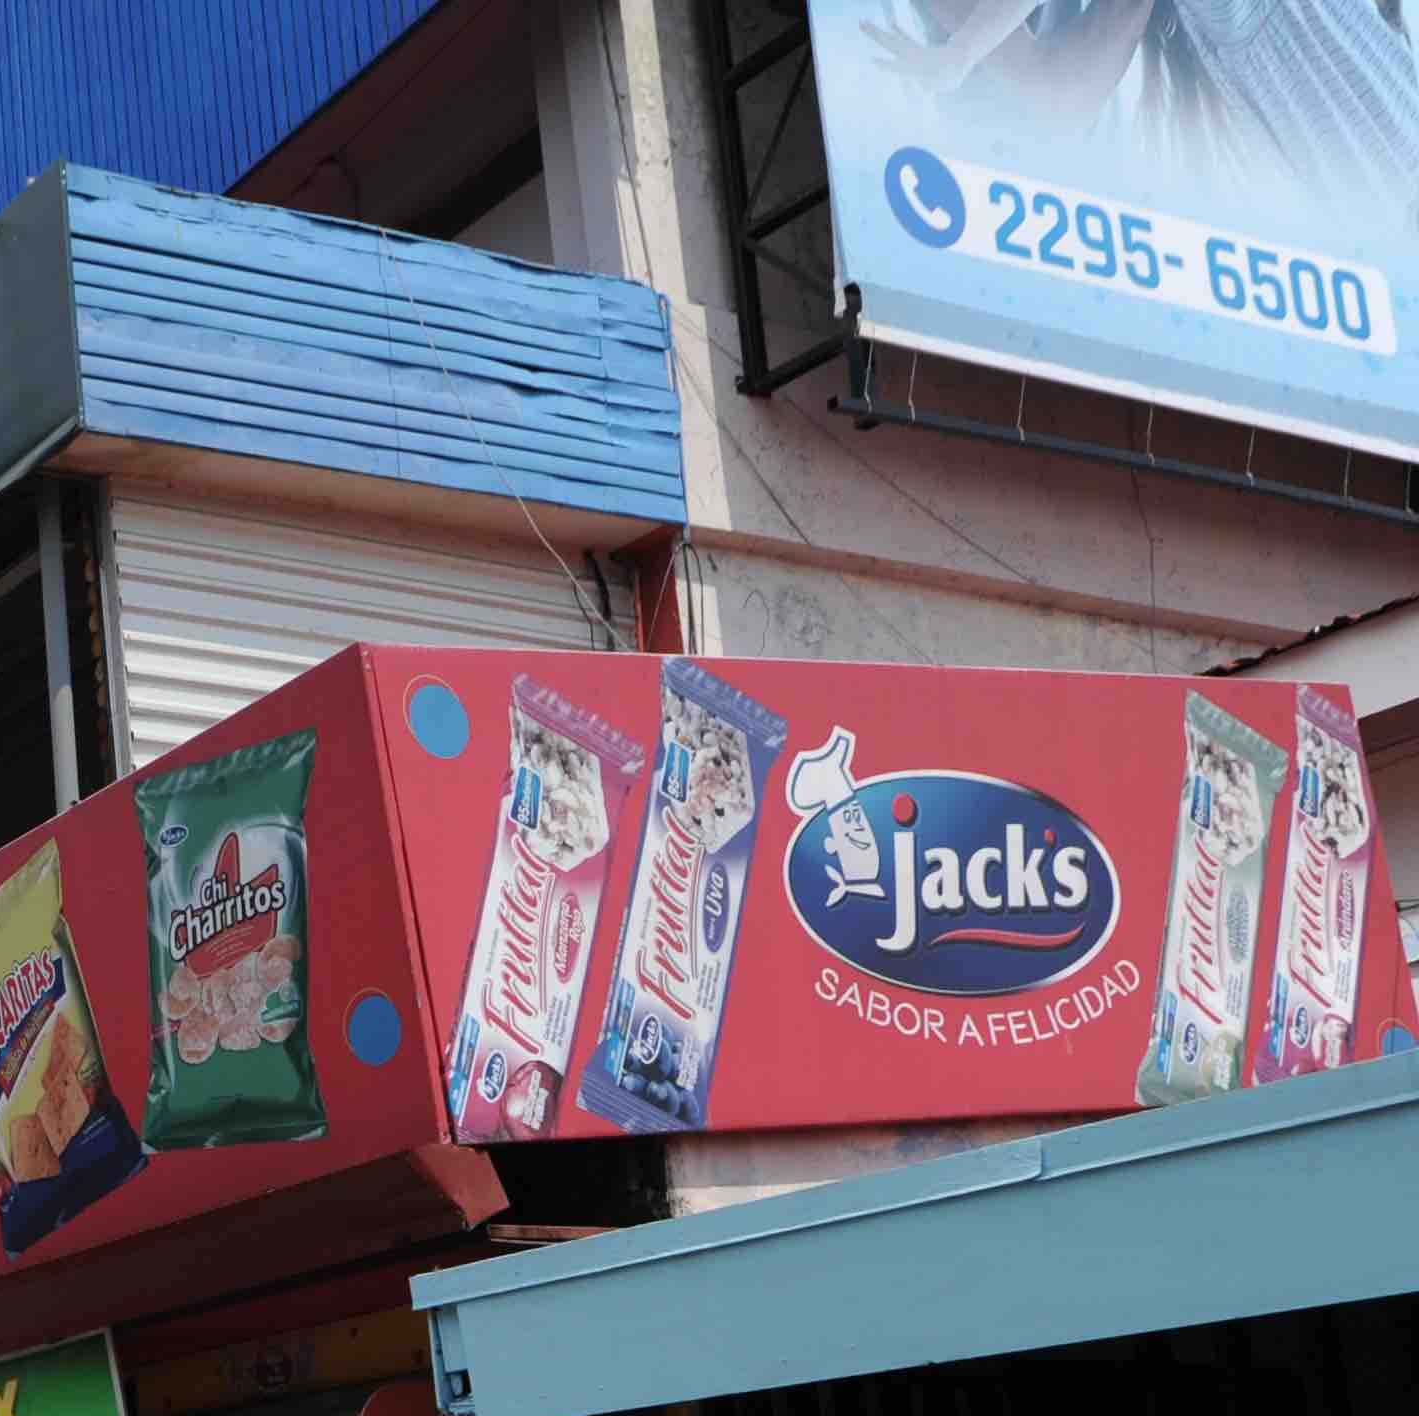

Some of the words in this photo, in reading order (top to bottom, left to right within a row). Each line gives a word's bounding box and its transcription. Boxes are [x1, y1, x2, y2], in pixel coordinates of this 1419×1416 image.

[988, 180, 1185, 289] 2295-
[1206, 236, 1372, 341] 6500
[170, 880, 285, 961] Charritos
[201, 872, 229, 907] Chi
[705, 871, 725, 919] Uva
[814, 968, 946, 1043] SABOR
[958, 1013, 986, 1046] A
[988, 959, 1142, 1048] FELICIDAD
